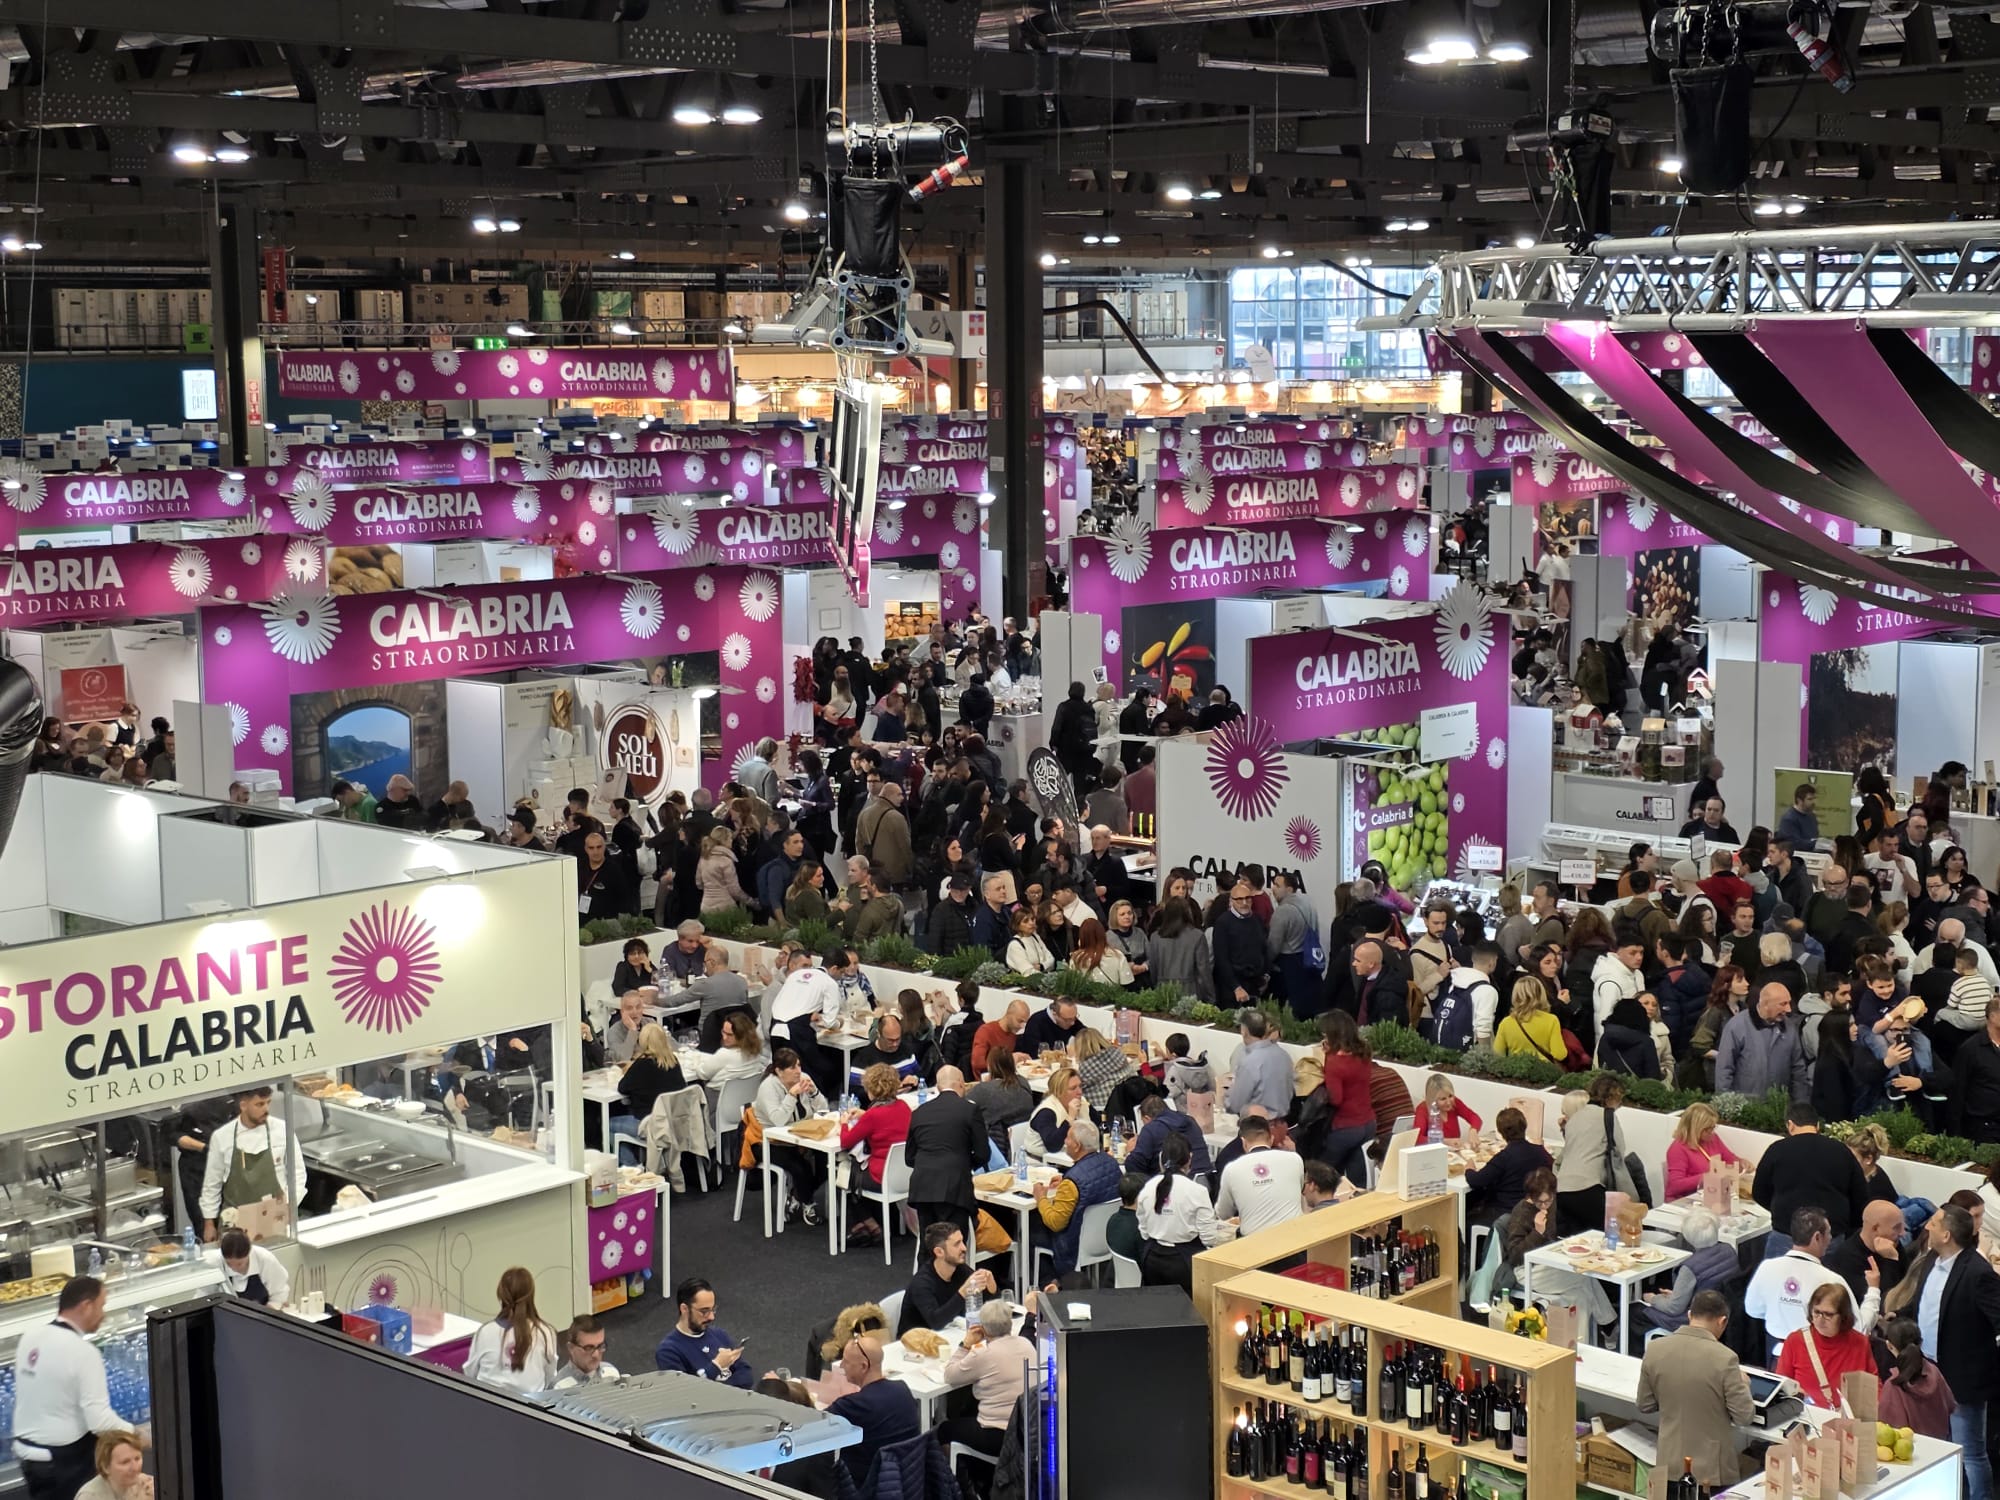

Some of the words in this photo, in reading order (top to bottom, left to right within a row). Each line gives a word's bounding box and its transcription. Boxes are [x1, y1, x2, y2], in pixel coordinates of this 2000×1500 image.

[287, 363, 335, 383] CALABRIA
[560, 361, 647, 382] CALABRIA
[561, 382, 649, 392] STRAORDINARIA
[650, 437, 728, 453] CALABR
[949, 425, 988, 439] CALA
[1214, 429, 1276, 446] CALABRIA
[306, 448, 400, 469] CALABRIA
[1212, 448, 1287, 472] CALABRIA
[64, 477, 189, 506] CALABRIA
[878, 466, 960, 492] ALABRIA
[1226, 477, 1320, 508] CALABRIA
[65, 501, 191, 518] STRAORDINARIA
[354, 491, 482, 523] CALABRIA
[1227, 503, 1321, 521] STRAORDINARIA
[355, 518, 484, 538] STRAORDINARIA
[717, 511, 830, 546] CALABRI
[719, 541, 831, 561] TRAORDINAR
[1169, 530, 1297, 573] CALABRIA
[0, 555, 125, 597] ABRIA
[1171, 564, 1298, 591] STRAORDINARIA
[370, 590, 574, 648] CALABRIA
[372, 634, 576, 672] STRAORDINARIA
[1295, 642, 1421, 691] CALABRIA
[1295, 678, 1423, 711] STRAORDINARIA
[618, 732, 653, 757] SOL
[615, 751, 658, 778] MEU
[1371, 808, 1406, 826] Calabria
[64, 993, 315, 1081] CALABRIA
[66, 1040, 319, 1109] STRAORDINARIA
